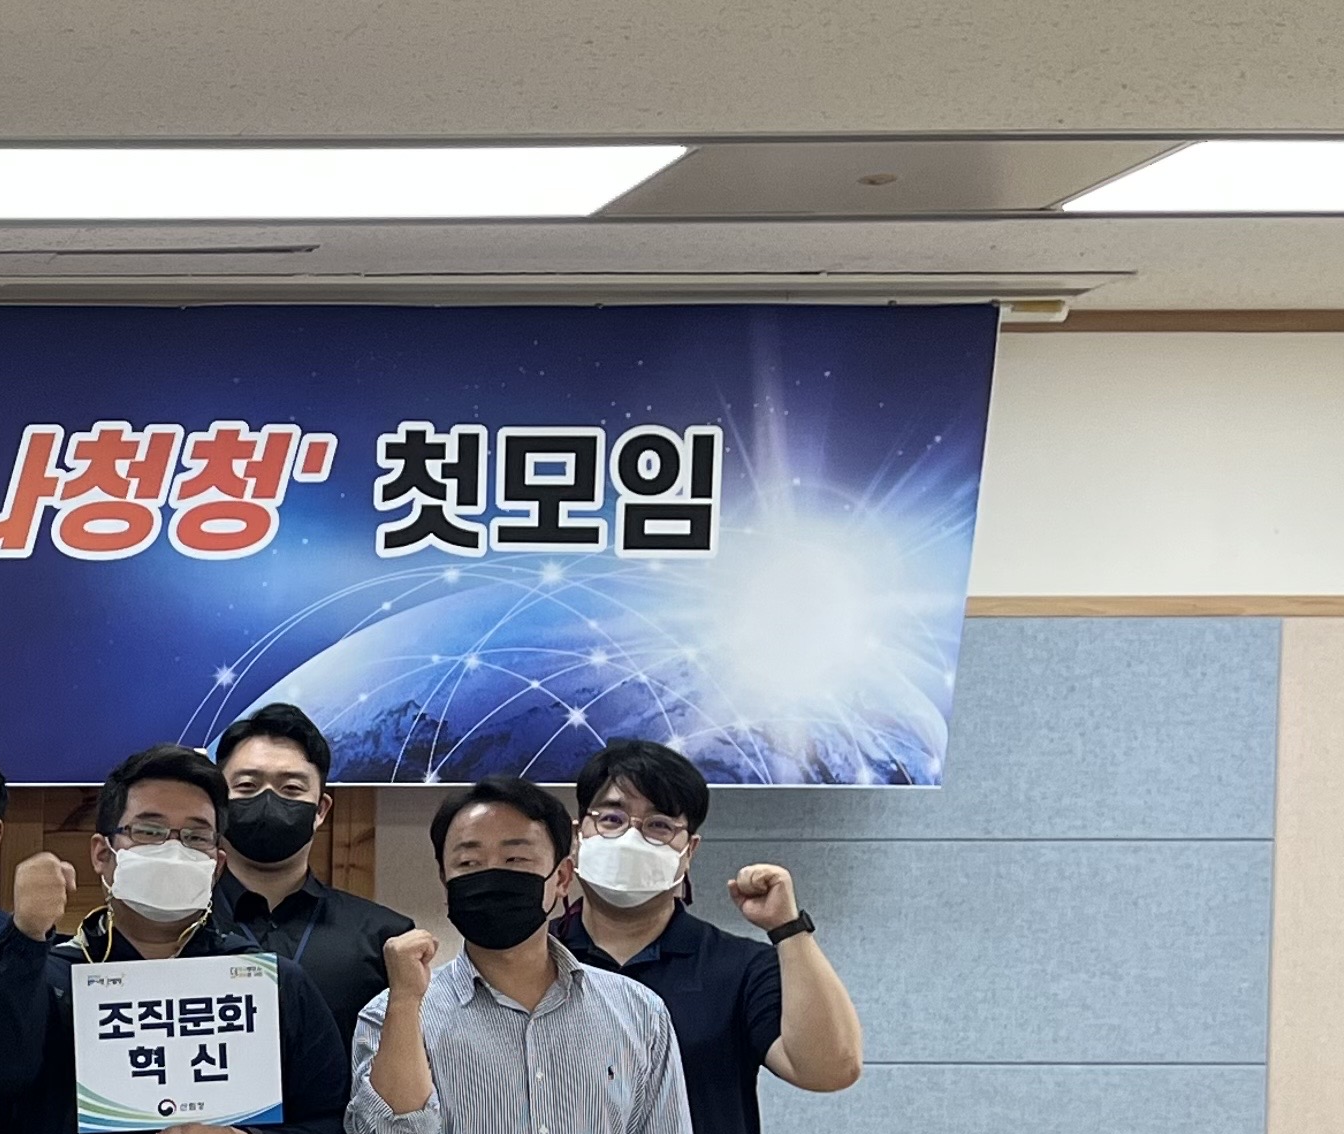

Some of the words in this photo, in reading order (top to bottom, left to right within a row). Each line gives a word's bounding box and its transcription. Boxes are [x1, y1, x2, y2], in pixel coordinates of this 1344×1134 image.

[372, 423, 725, 557] 첫모임
[98, 993, 258, 1041] 조직문화
[128, 1045, 167, 1085] 혁
[190, 1042, 229, 1083] 신
